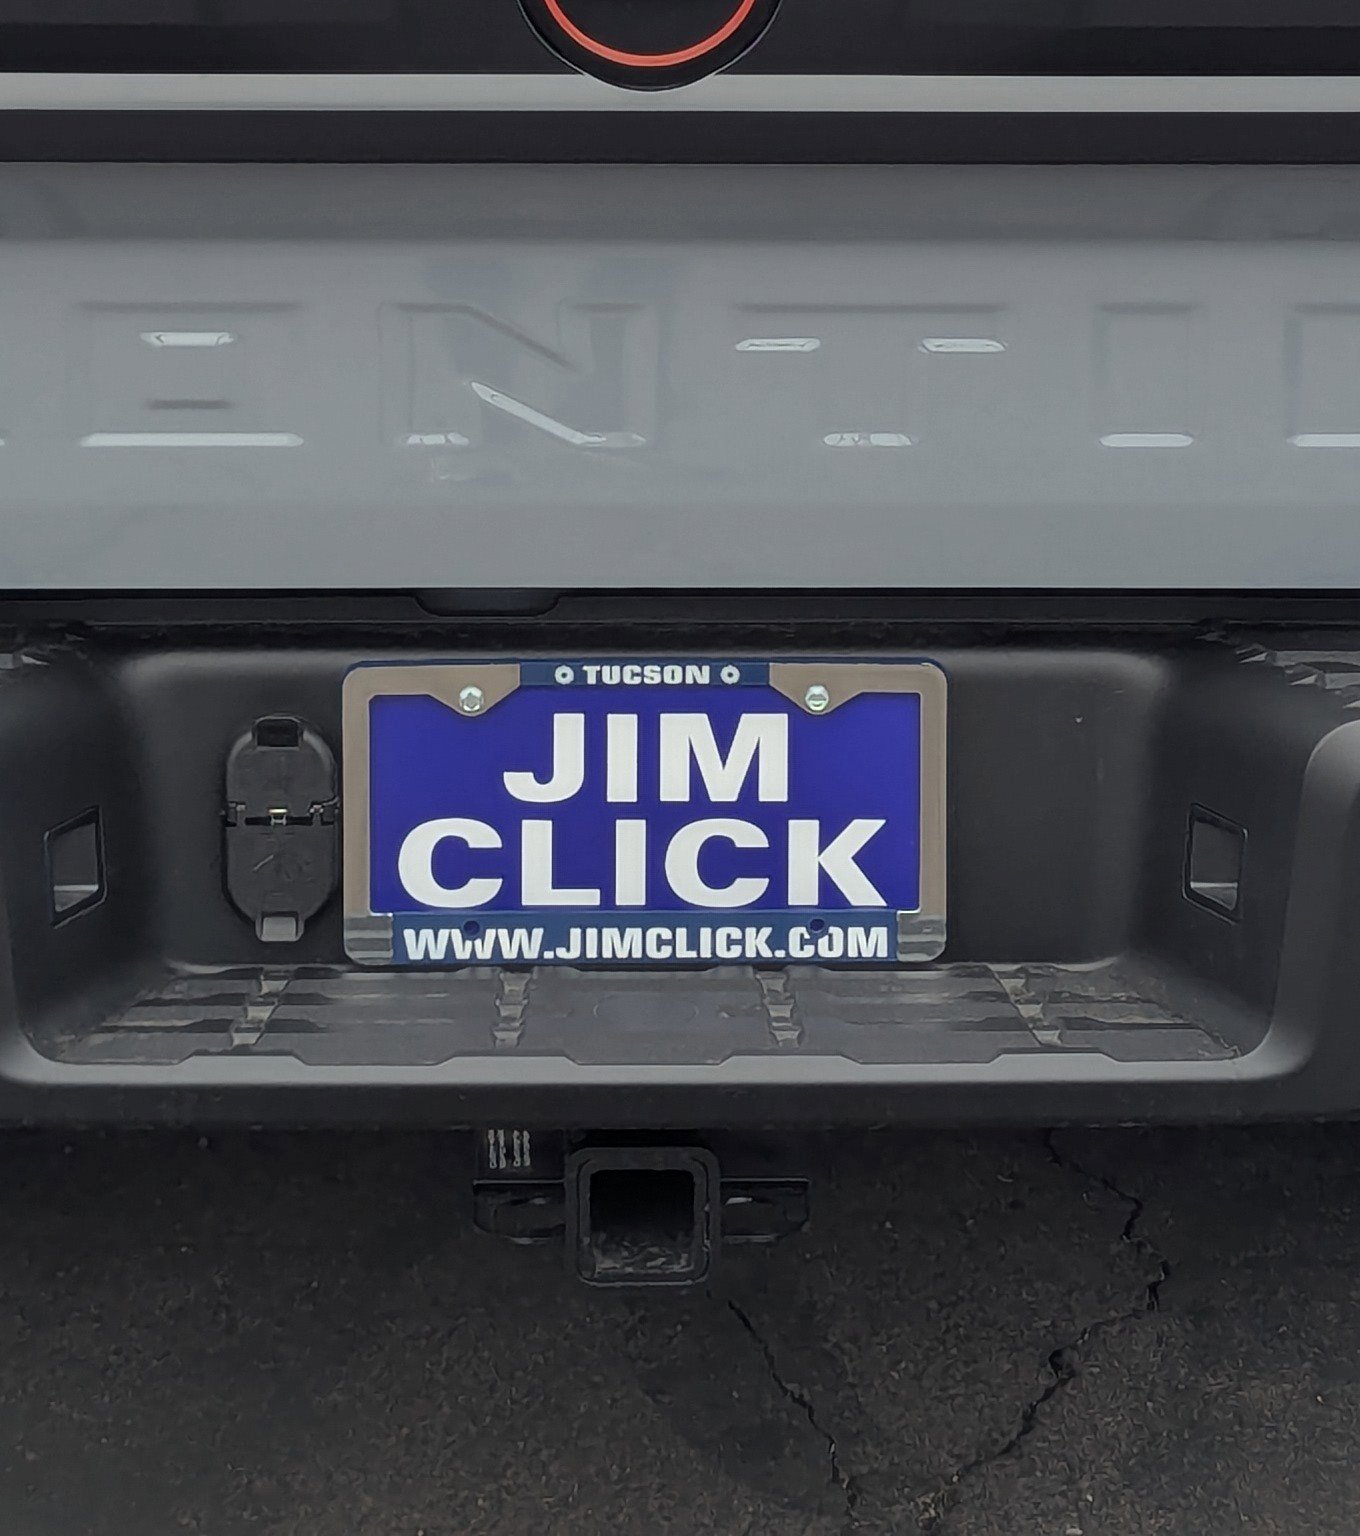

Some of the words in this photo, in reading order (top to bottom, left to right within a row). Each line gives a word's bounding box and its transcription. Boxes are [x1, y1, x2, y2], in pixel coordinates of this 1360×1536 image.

[582, 664, 710, 685] TUCSON
[502, 712, 789, 803] JIM
[397, 817, 888, 908] CLICK
[403, 927, 888, 961] WWW.JIMCLICK.COM
